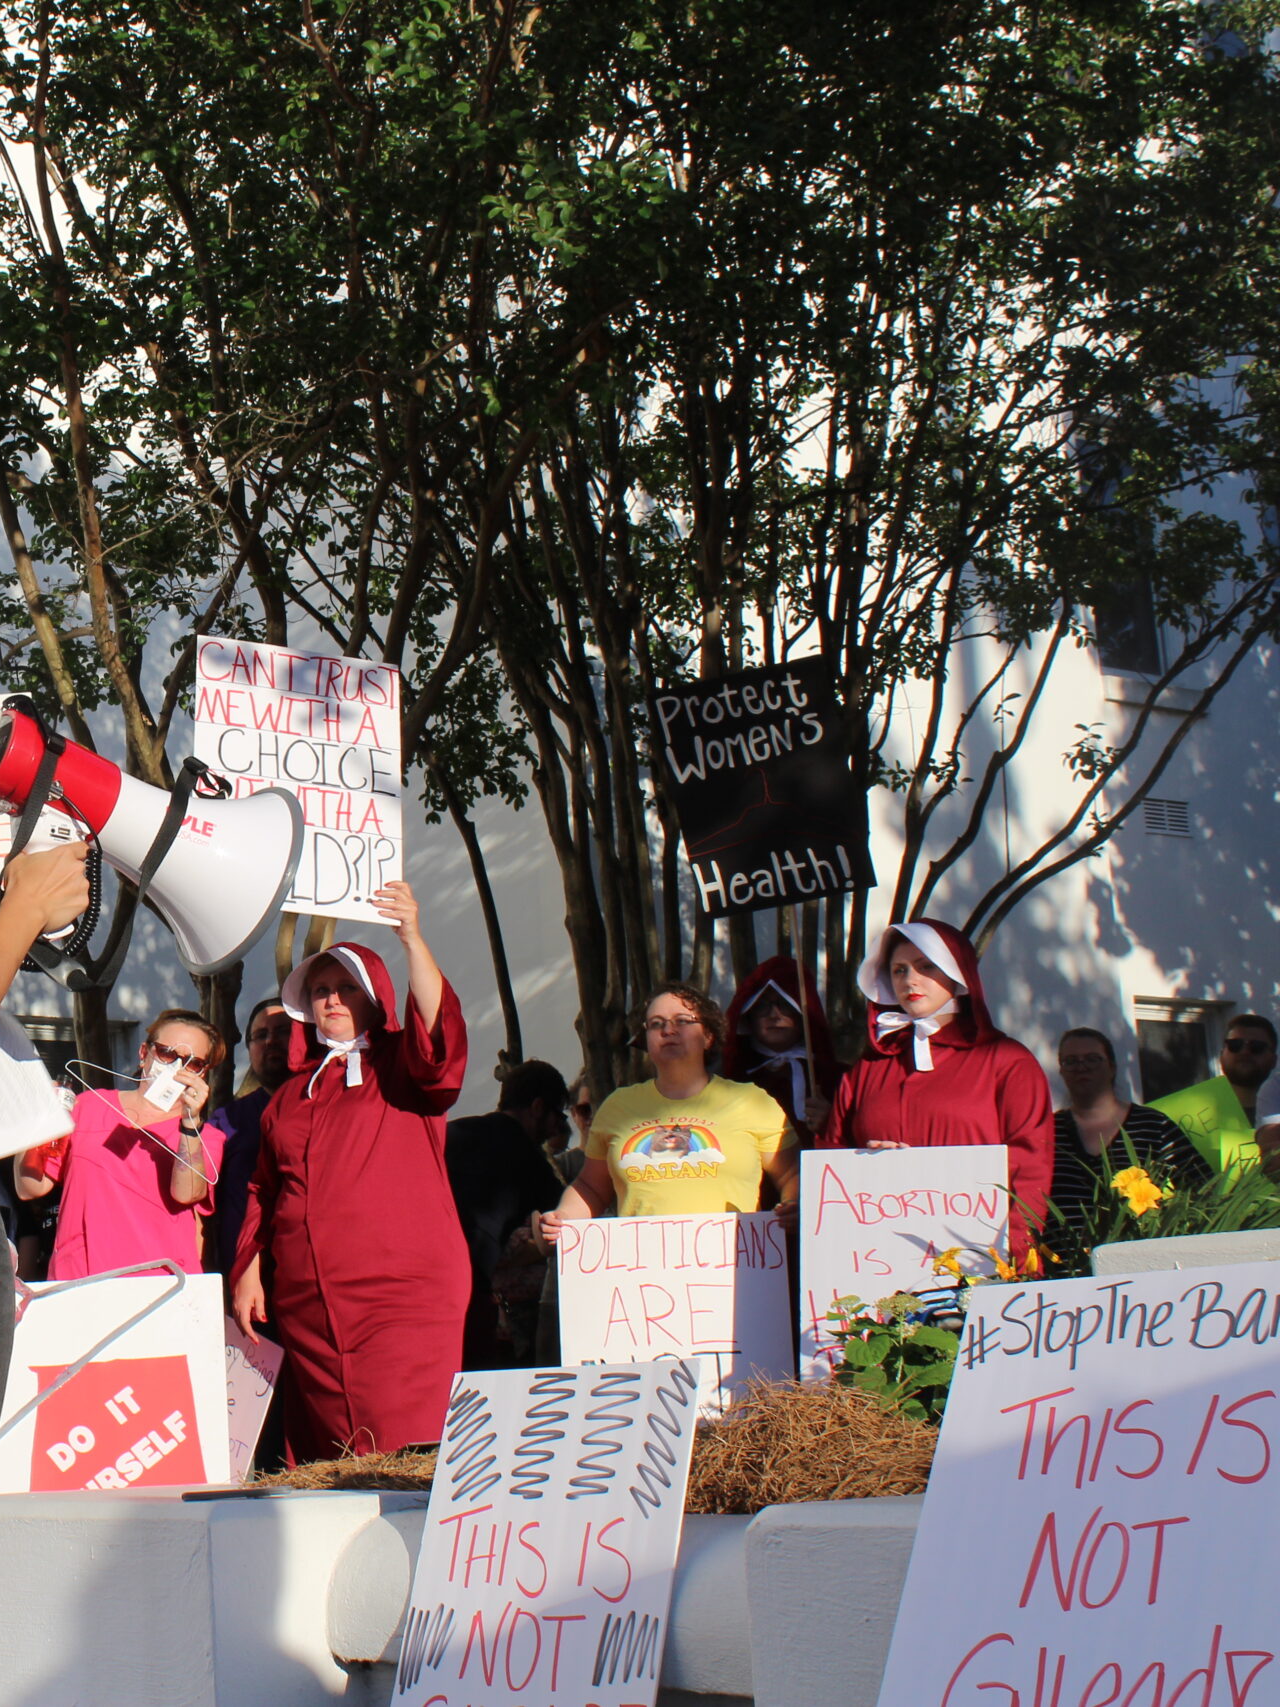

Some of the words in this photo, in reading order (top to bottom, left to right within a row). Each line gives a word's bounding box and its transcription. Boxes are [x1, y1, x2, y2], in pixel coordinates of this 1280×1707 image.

[310, 656, 401, 710] TRUST
[656, 672, 808, 744] Protect
[195, 685, 247, 728] ME
[248, 691, 342, 744] WITH
[352, 705, 383, 750] A
[218, 728, 400, 798] CHOICE
[354, 798, 384, 838] A
[692, 844, 855, 913] Health!
[630, 1118, 662, 1132] NOT
[625, 1161, 720, 1183] SATAN
[559, 1218, 784, 1276] POLITICIANS
[852, 1248, 893, 1277] IS
[603, 1283, 739, 1348] ARE
[45, 1424, 96, 1473] DO
[104, 1385, 142, 1426] IT
[1185, 1389, 1277, 1486] IS
[438, 1503, 548, 1599] THIS
[576, 1517, 632, 1604] IS
[1017, 1505, 1191, 1612] NOT
[457, 1600, 588, 1693] NOT
